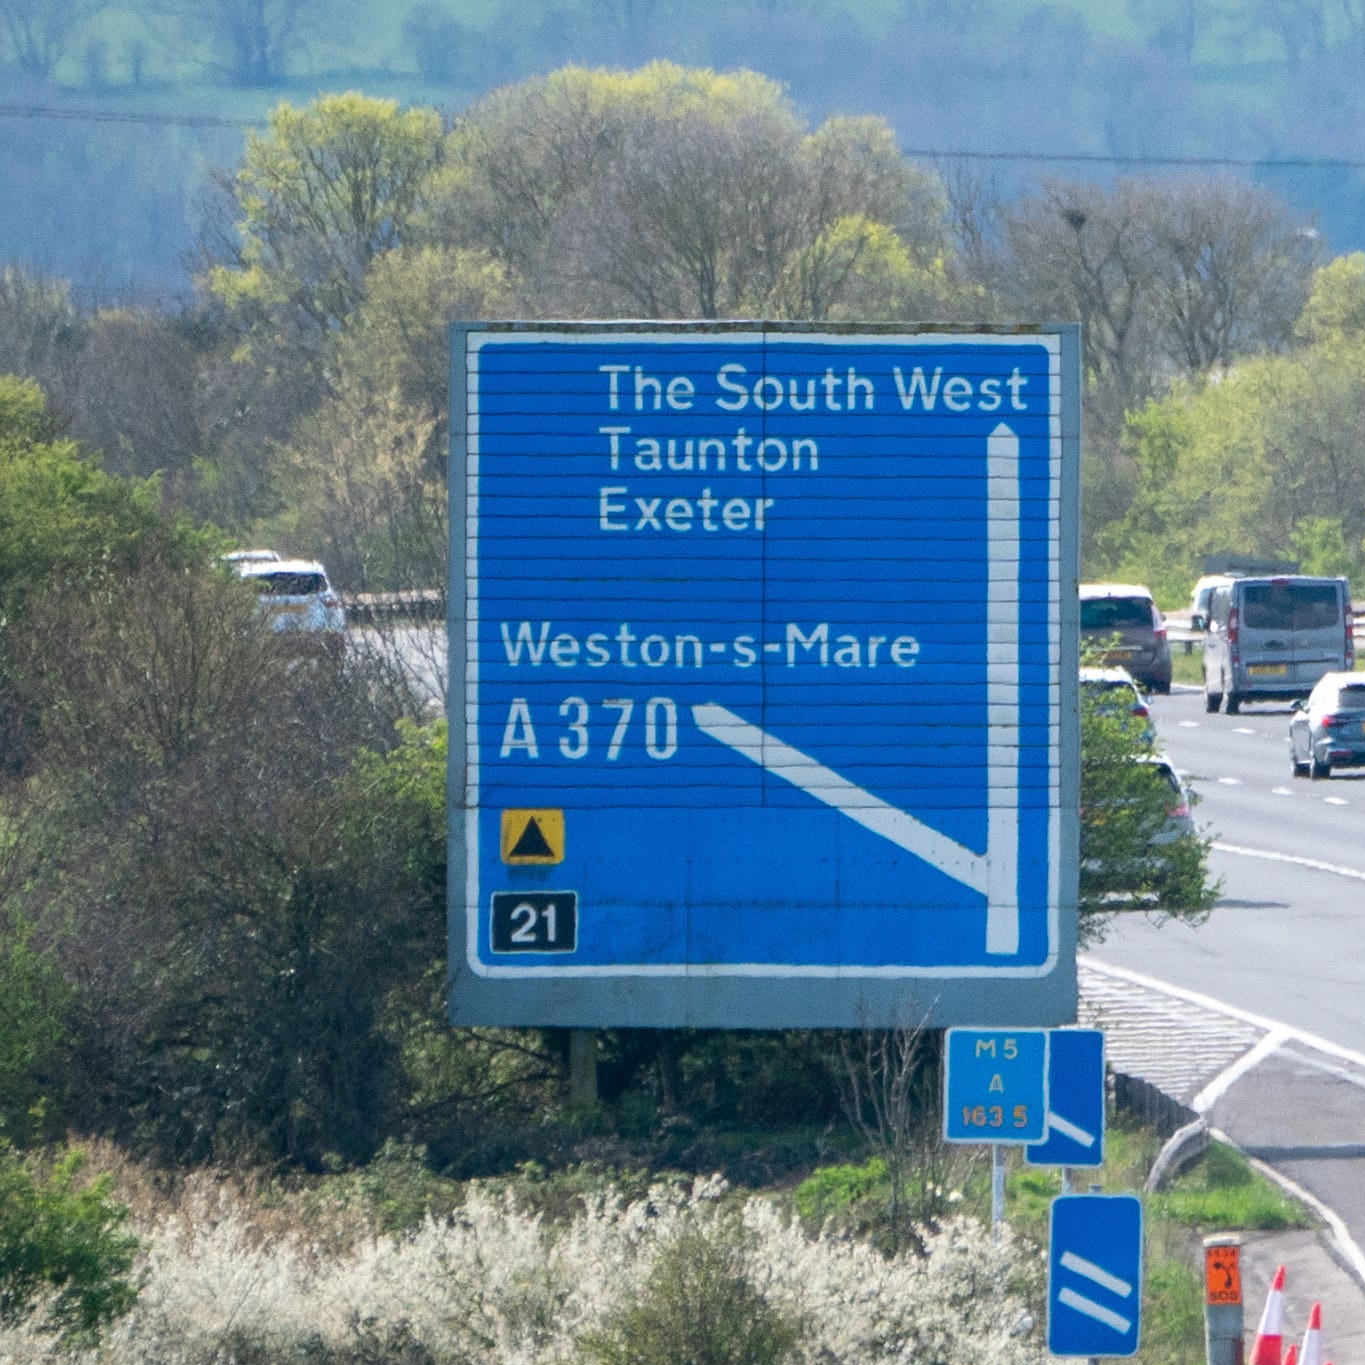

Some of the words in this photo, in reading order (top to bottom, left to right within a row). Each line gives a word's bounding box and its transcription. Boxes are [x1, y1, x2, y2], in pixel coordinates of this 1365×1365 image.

[599, 363, 695, 412] The
[716, 362, 875, 413] South
[893, 365, 1029, 413] West
[599, 425, 820, 473] Taunton
[599, 485, 775, 532] Exeter
[501, 620, 921, 669] Weston-s-Mare
[509, 902, 557, 944] 21
[988, 1073, 1005, 1093] A
